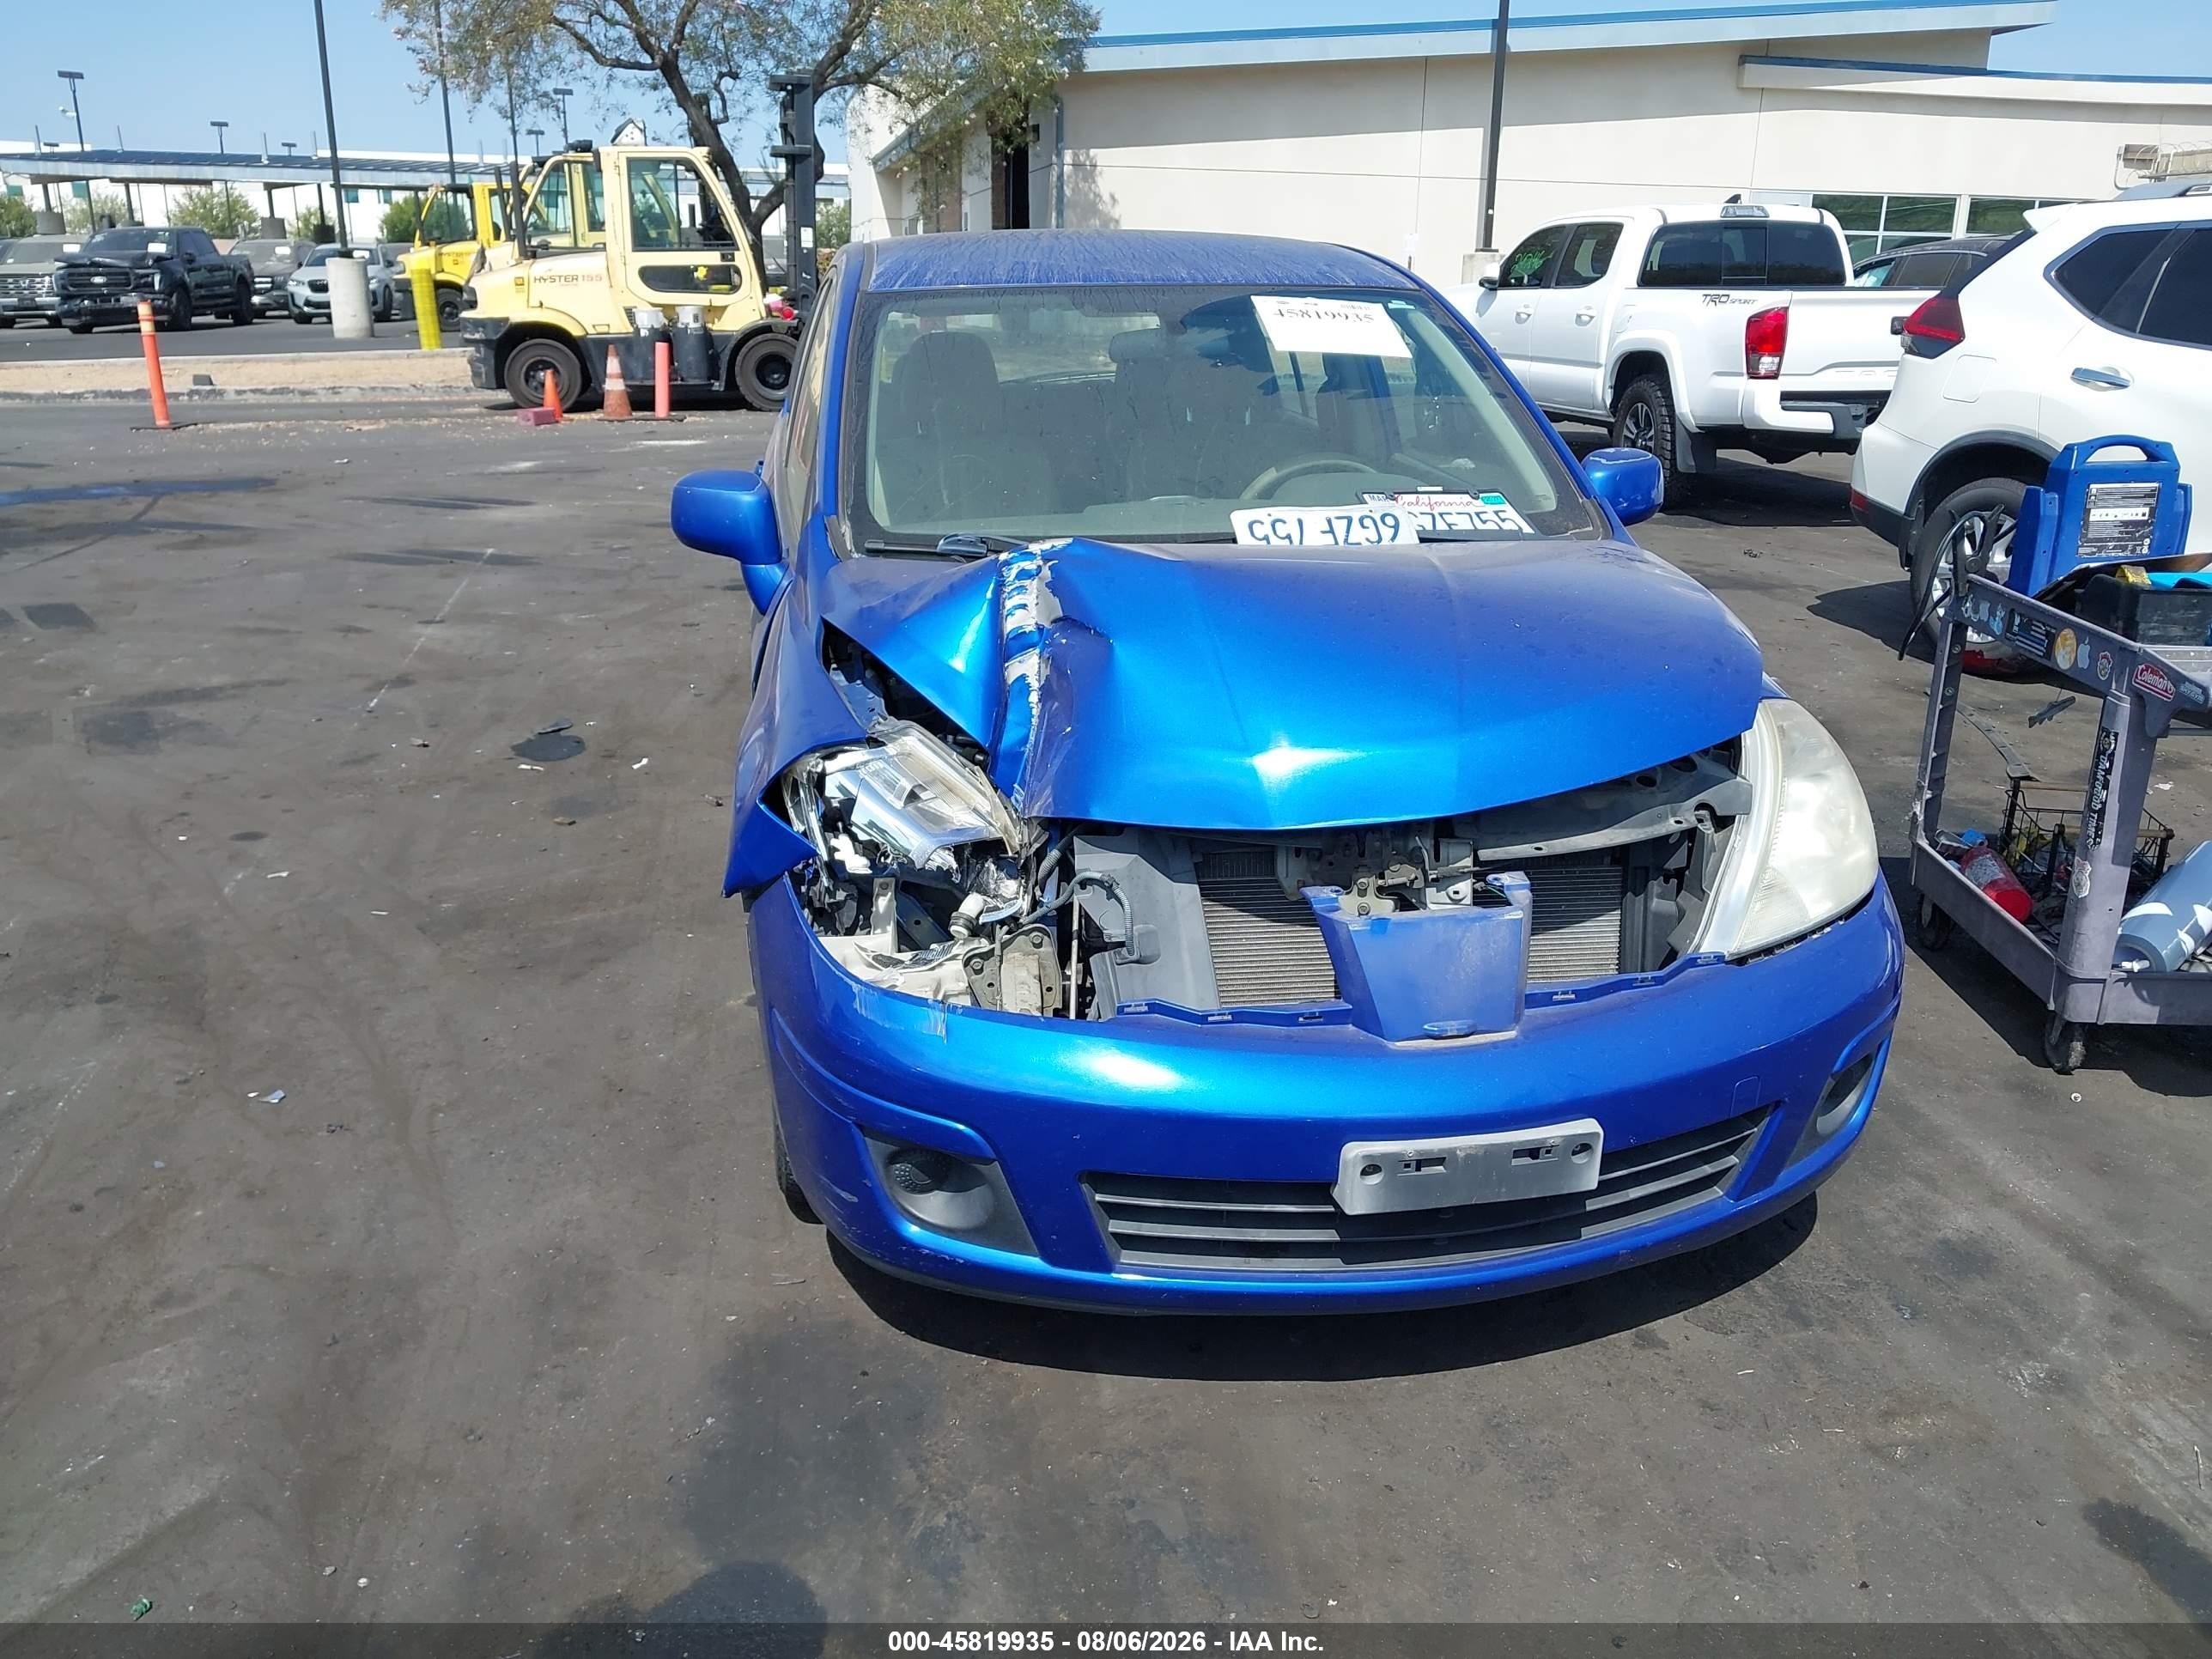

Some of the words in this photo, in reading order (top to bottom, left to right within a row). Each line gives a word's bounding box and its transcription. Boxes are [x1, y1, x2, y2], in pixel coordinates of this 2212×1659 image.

[534, 275, 579, 283] HYSTER
[1395, 494, 1486, 511] California
[2137, 665, 2166, 690] Coleman
[2087, 812, 2098, 839] TIME
